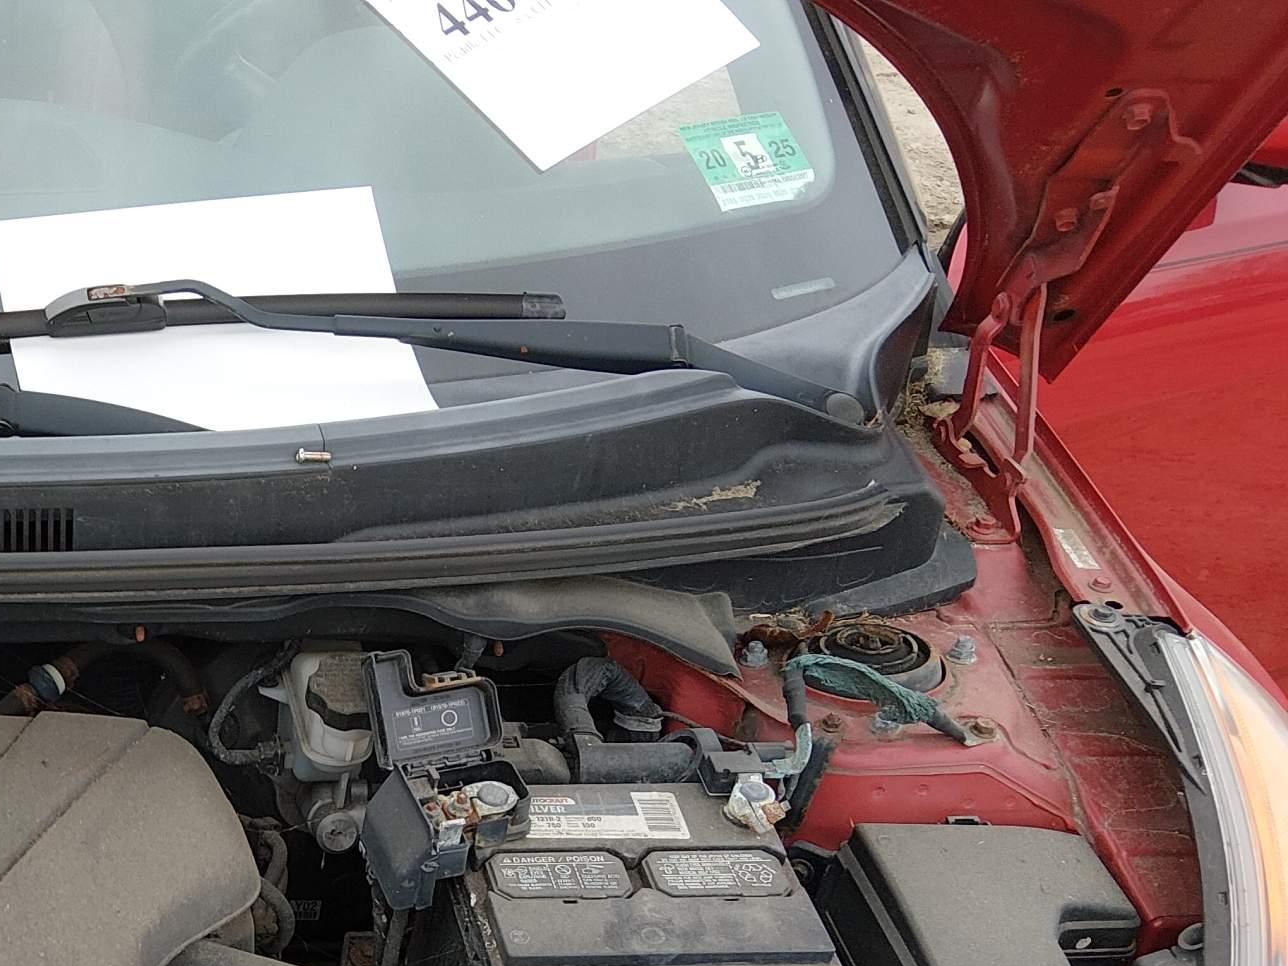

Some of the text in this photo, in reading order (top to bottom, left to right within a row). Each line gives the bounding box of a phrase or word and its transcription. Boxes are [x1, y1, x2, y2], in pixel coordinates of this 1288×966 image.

[699, 149, 727, 169] 20
[733, 139, 759, 170] 5
[768, 138, 797, 158] 25
[530, 805, 566, 813] ILVER
[512, 855, 556, 863] DANGER
